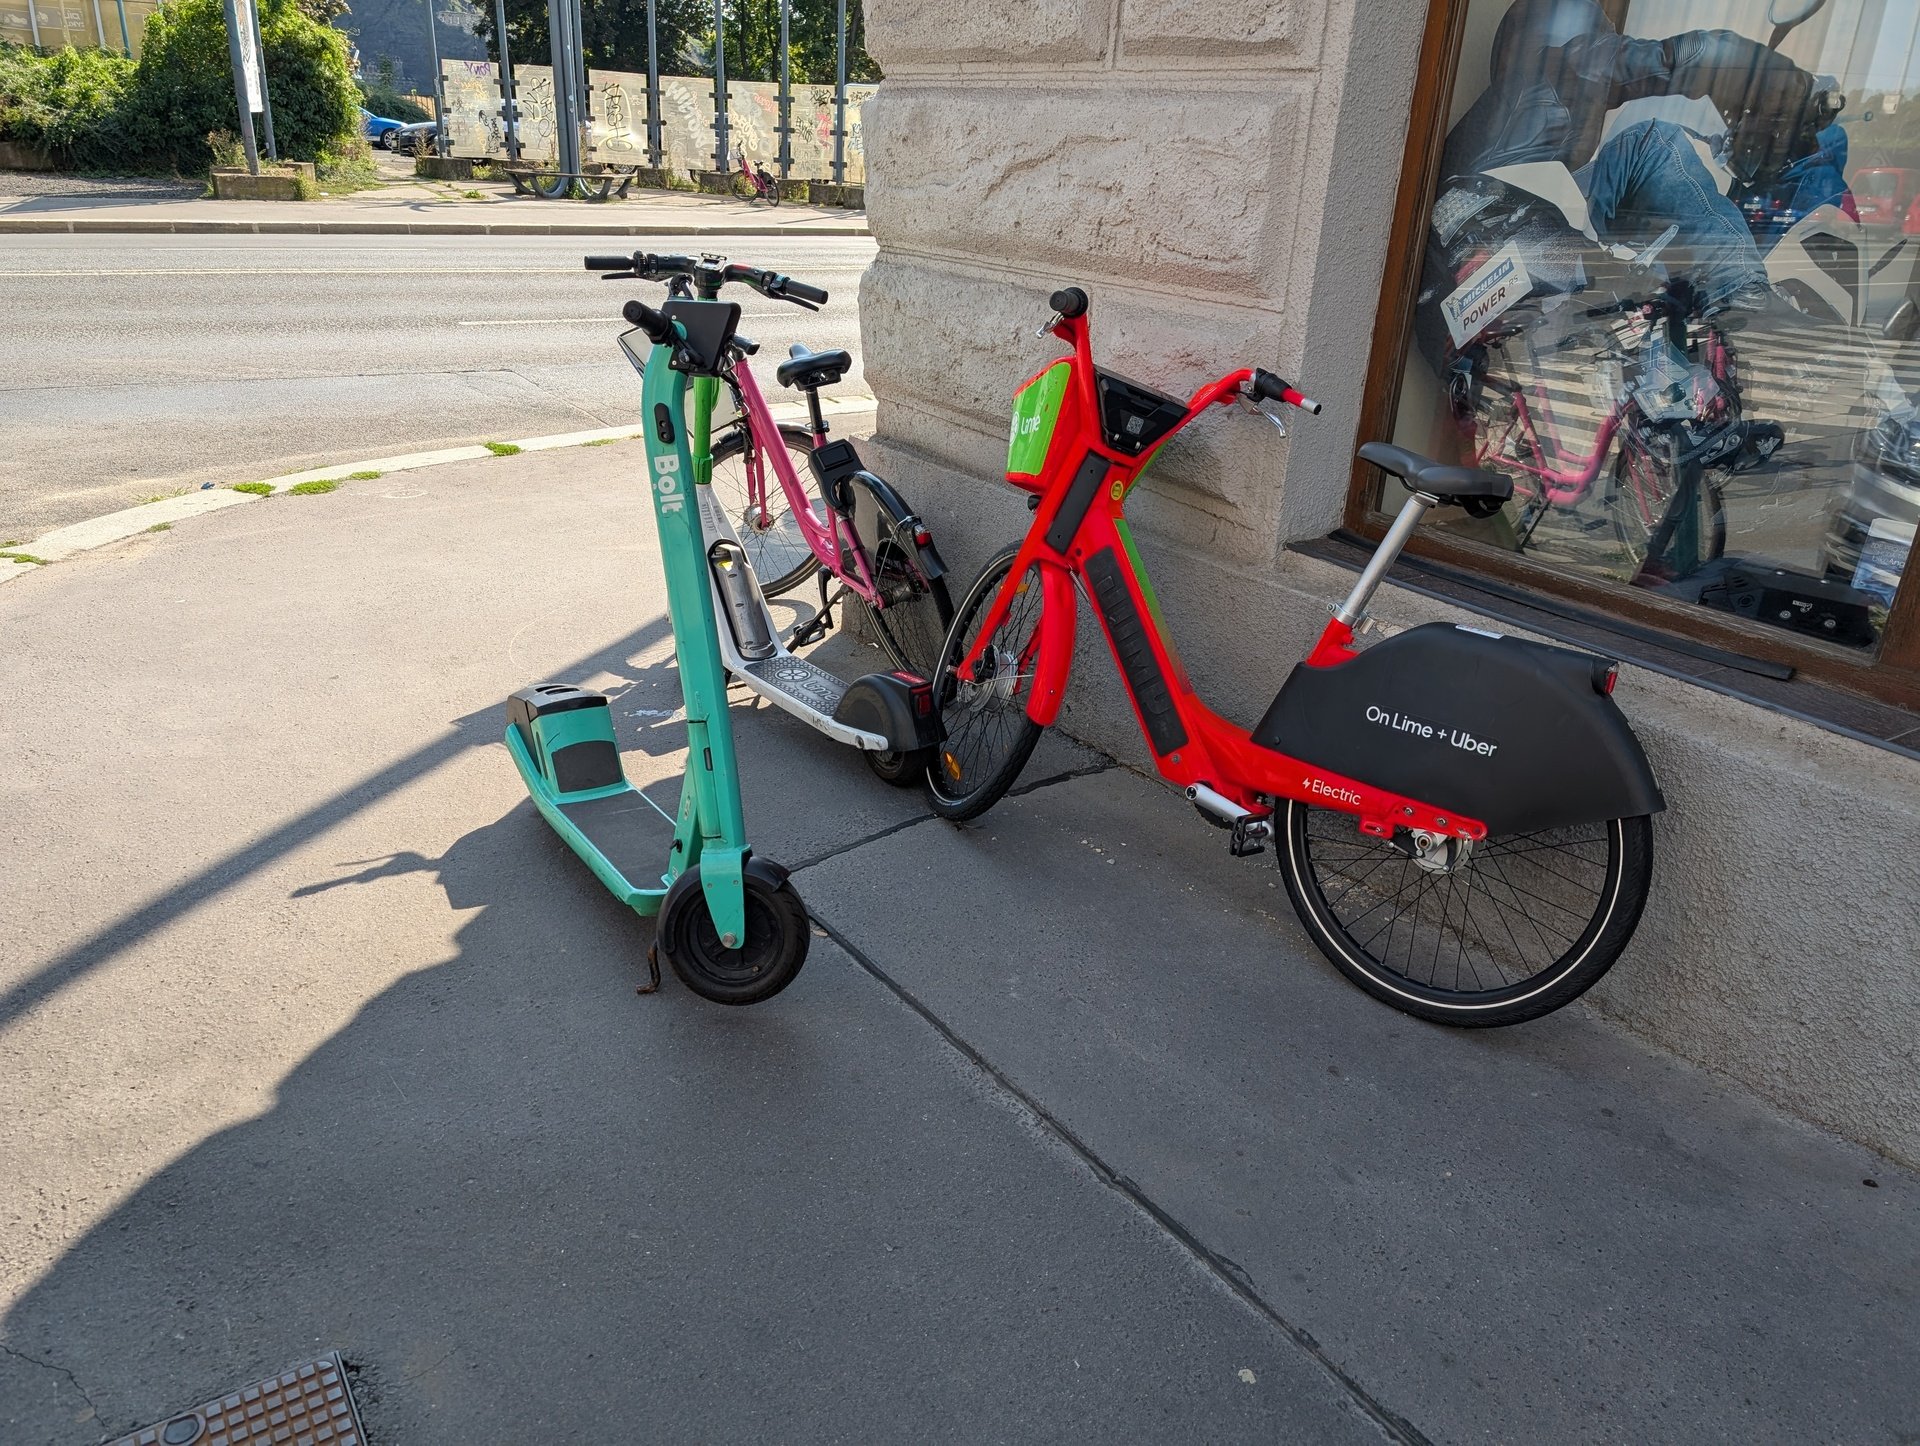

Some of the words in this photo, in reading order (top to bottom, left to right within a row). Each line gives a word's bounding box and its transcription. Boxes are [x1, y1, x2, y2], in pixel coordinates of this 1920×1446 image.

[1462, 261, 1511, 306] MICHELIN
[1463, 286, 1506, 330] POWER
[1508, 275, 1518, 287] RS
[653, 454, 684, 514] Bolt
[1366, 706, 1390, 725] On
[1392, 712, 1433, 738] Lime
[1450, 729, 1498, 757] Uber
[1312, 779, 1362, 805] Electric
